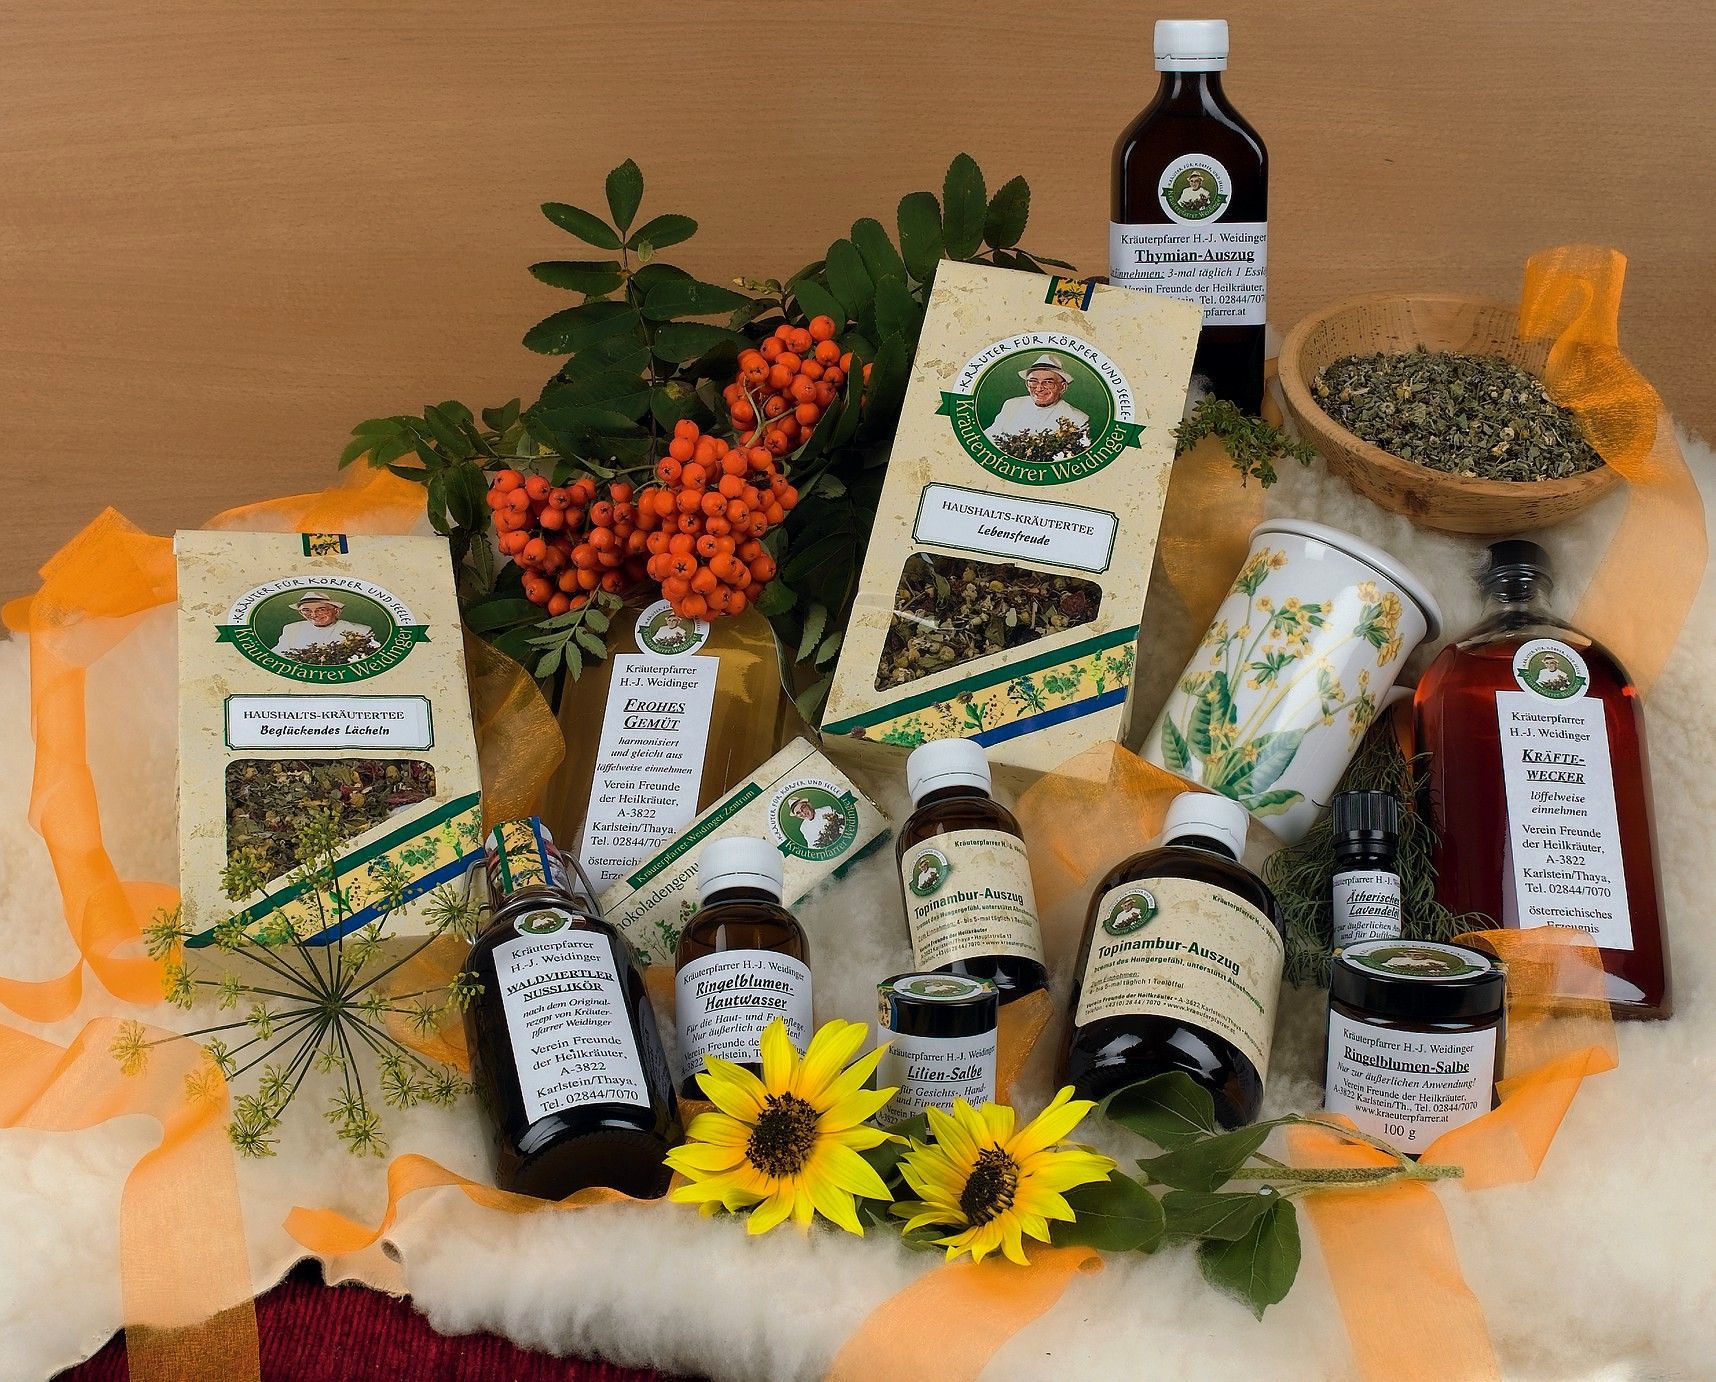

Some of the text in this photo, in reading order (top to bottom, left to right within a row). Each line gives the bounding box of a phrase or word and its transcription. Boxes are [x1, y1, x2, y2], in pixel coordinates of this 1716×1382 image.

[1122, 234, 1190, 246] Kräuterpfarrer
[1193, 234, 1217, 243] H.-J.
[1135, 249, 1255, 264] Thymian-Auszug
[1168, 268, 1200, 278] 3-mal
[1200, 268, 1232, 278] täglich
[1156, 282, 1264, 293] Freunde der Heilkräuter,
[1200, 295, 1217, 304] Tel.
[1014, 335, 1043, 347] FÜR
[1048, 335, 1098, 363] KÖRPER
[1101, 362, 1122, 387] UND
[956, 399, 1127, 482] Kräuterpfarrer Weidinger
[942, 501, 1094, 536] HAUSHALTS-KRÄUTERTEE
[977, 524, 1050, 546] Lebensfreude
[275, 579, 304, 590] FÜR
[309, 578, 363, 591] KÖRPER
[368, 587, 392, 603] UND
[234, 628, 413, 681] Kräuterpfarrer Weidinger
[626, 664, 697, 676] Kräuterpfarrer
[620, 677, 698, 690] H.-J. Weidinger
[624, 698, 686, 714] FROHES
[244, 710, 404, 720] HAUSHALTS-KRÄUTERTEE
[623, 715, 680, 731] GEMÜT
[1511, 711, 1585, 726] Kräuterpfarrer
[260, 725, 390, 737] Beglückendes Lächeln
[1510, 727, 1591, 742] H.-J. Weidinger
[618, 737, 679, 748] harmonisiert
[611, 749, 683, 760] und gleicht aus
[1522, 749, 1586, 766] KRÄFTE-
[597, 763, 693, 774] löffelweise einnehmen
[1526, 769, 1586, 784] WECKER
[604, 780, 680, 792] Verein Freunde
[599, 793, 679, 806] der Heilkräuter,
[1530, 790, 1586, 804] löffelweise
[617, 808, 656, 818] A-3822
[1531, 805, 1588, 817] einnehmen
[592, 822, 677, 834] Karlstein/Thaya,
[1522, 824, 1602, 839] Verein Freunde
[591, 835, 609, 846] Tel.
[636, 789, 755, 884] Kräuterpfarrer-Weidinger-Zentrum
[786, 841, 848, 860] Kräuterpfarrer
[1522, 839, 1605, 854] der Heilkräuter,
[1546, 854, 1586, 866] A-3822
[1523, 868, 1611, 884] Karlstein/Thaya,
[1525, 882, 1611, 898] Tel. 02844/7070
[914, 888, 1024, 919] Topinambur-Auszug
[1529, 905, 1613, 920] österreichisches
[1355, 931, 1367, 940] für
[512, 940, 594, 959] Kräuterpfarrer
[1098, 937, 1240, 976] Topinambur-Auszug
[511, 952, 601, 974] H.-J. Weidinger
[683, 960, 766, 985] Kräuterpfarrer H.-J.
[506, 970, 615, 996] WALDVIERTLER
[696, 974, 794, 999] Ringelblumen-
[523, 981, 604, 1003] NUSSLIKÖR
[523, 998, 611, 1018] nach dem Original-
[705, 994, 787, 1013] Hautwasser
[526, 1015, 552, 1028] rezept
[574, 1008, 613, 1016] Kräuter-
[700, 1018, 712, 1029] die
[715, 1014, 742, 1024] Haut-
[745, 1012, 762, 1021] und
[532, 1018, 612, 1039] pfarrer Weidinger
[692, 1023, 752, 1043] Nur äußerlich
[531, 1036, 622, 1055] Verein Freunde
[708, 1038, 745, 1052] Freunde
[748, 1038, 760, 1046] de
[1343, 1028, 1474, 1055] Kräuterpfarrer H.-J. Weidinger
[533, 1049, 627, 1071] der Heilkräuter,
[889, 1045, 943, 1061] Kräuterpfarrer
[947, 1052, 966, 1061] H.-J.
[1344, 1045, 1470, 1075] Ringelblumen-Salbe
[560, 1062, 606, 1076] A-3822
[907, 1064, 982, 1082] Lilien-Salbe
[1337, 1061, 1477, 1089] Nur zur äußerlichen Anwendung!
[537, 1076, 637, 1098] Karlstein/Thaya,
[899, 1085, 913, 1095] für
[1343, 1078, 1467, 1102] Verein Freunde der Heilkräuter,
[540, 1090, 638, 1112] Tel. 02844/7070
[1333, 1085, 1355, 1100] A-3822
[1415, 1103, 1430, 1112] Tel.
[1433, 1102, 1478, 1113] 02844/7070
[887, 1104, 908, 1117] Verein
[1355, 1104, 1449, 1124] www.kraeuterpfarrer.at
[1384, 1123, 1416, 1140] 100 g
